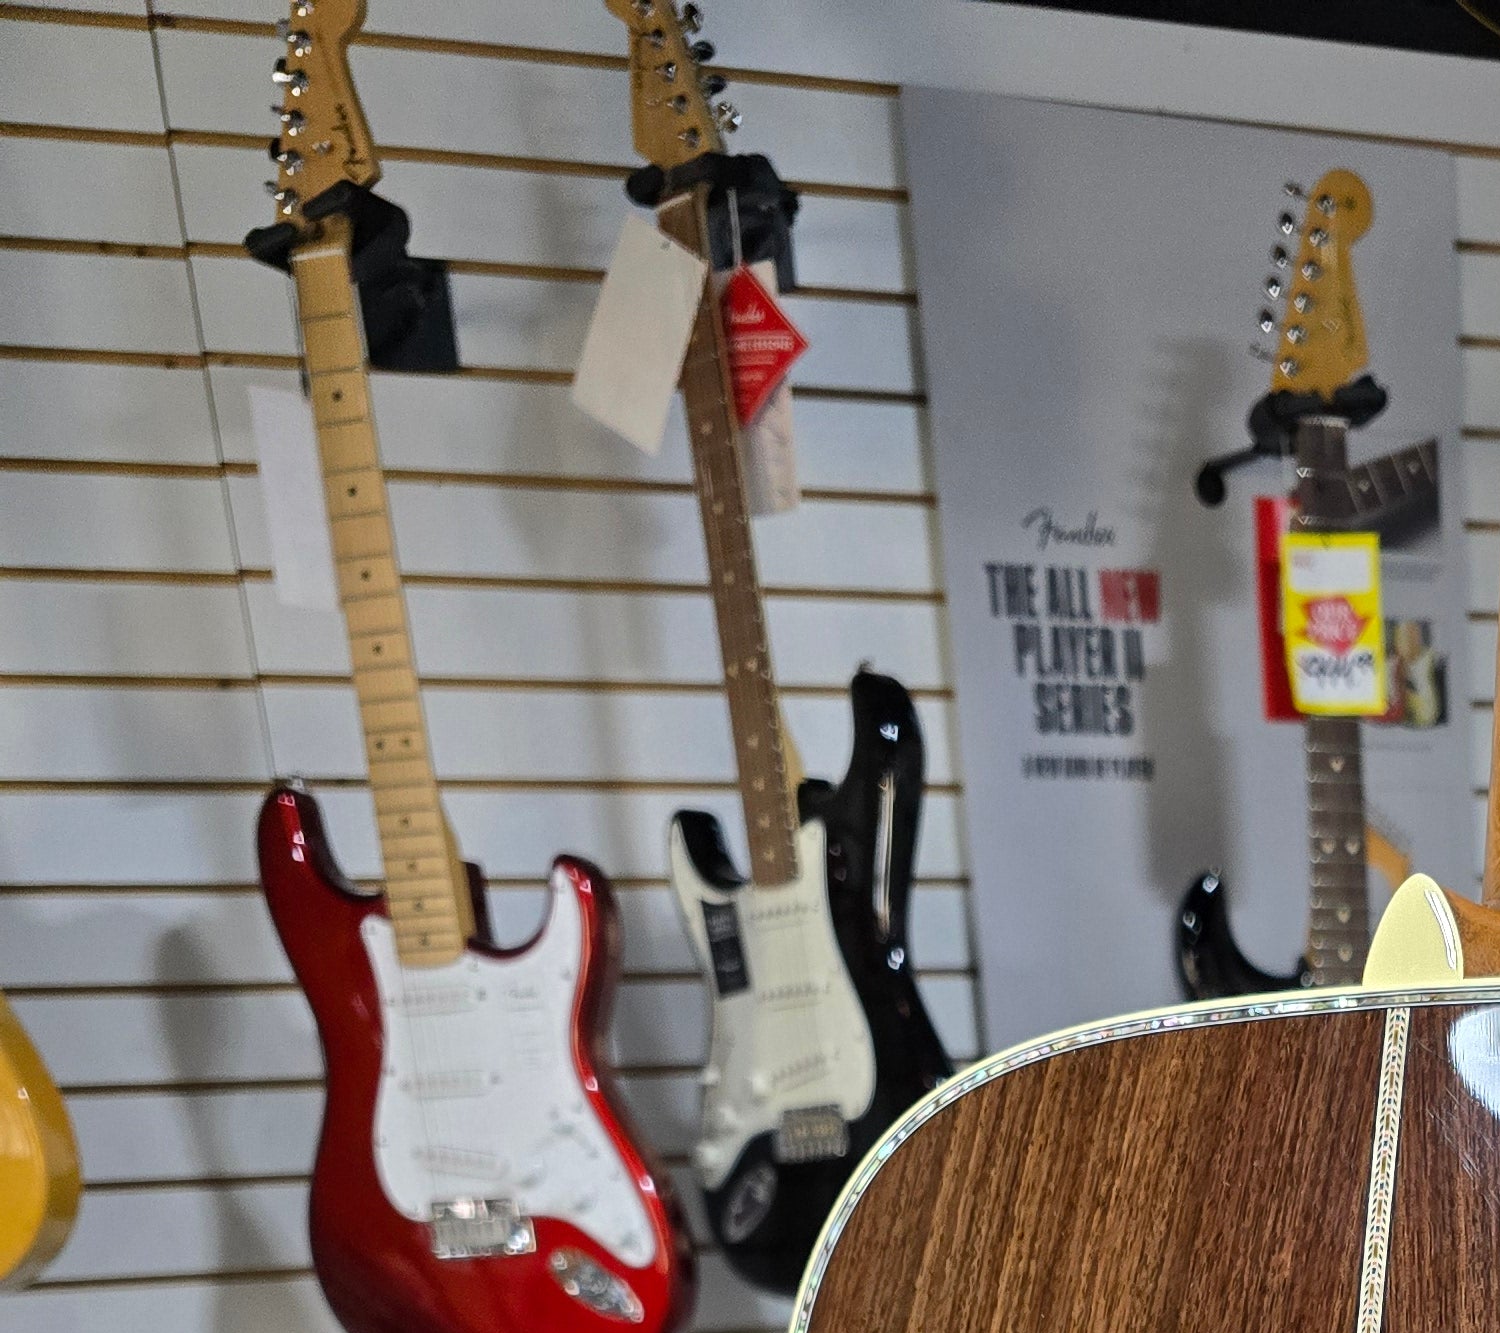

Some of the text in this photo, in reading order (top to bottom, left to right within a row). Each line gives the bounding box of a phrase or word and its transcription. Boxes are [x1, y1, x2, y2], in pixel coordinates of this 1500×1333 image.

[984, 561, 1037, 618] THE
[1045, 565, 1092, 620] ALL
[1013, 625, 1116, 677] PLAYER
[1035, 682, 1134, 735] SERIES
